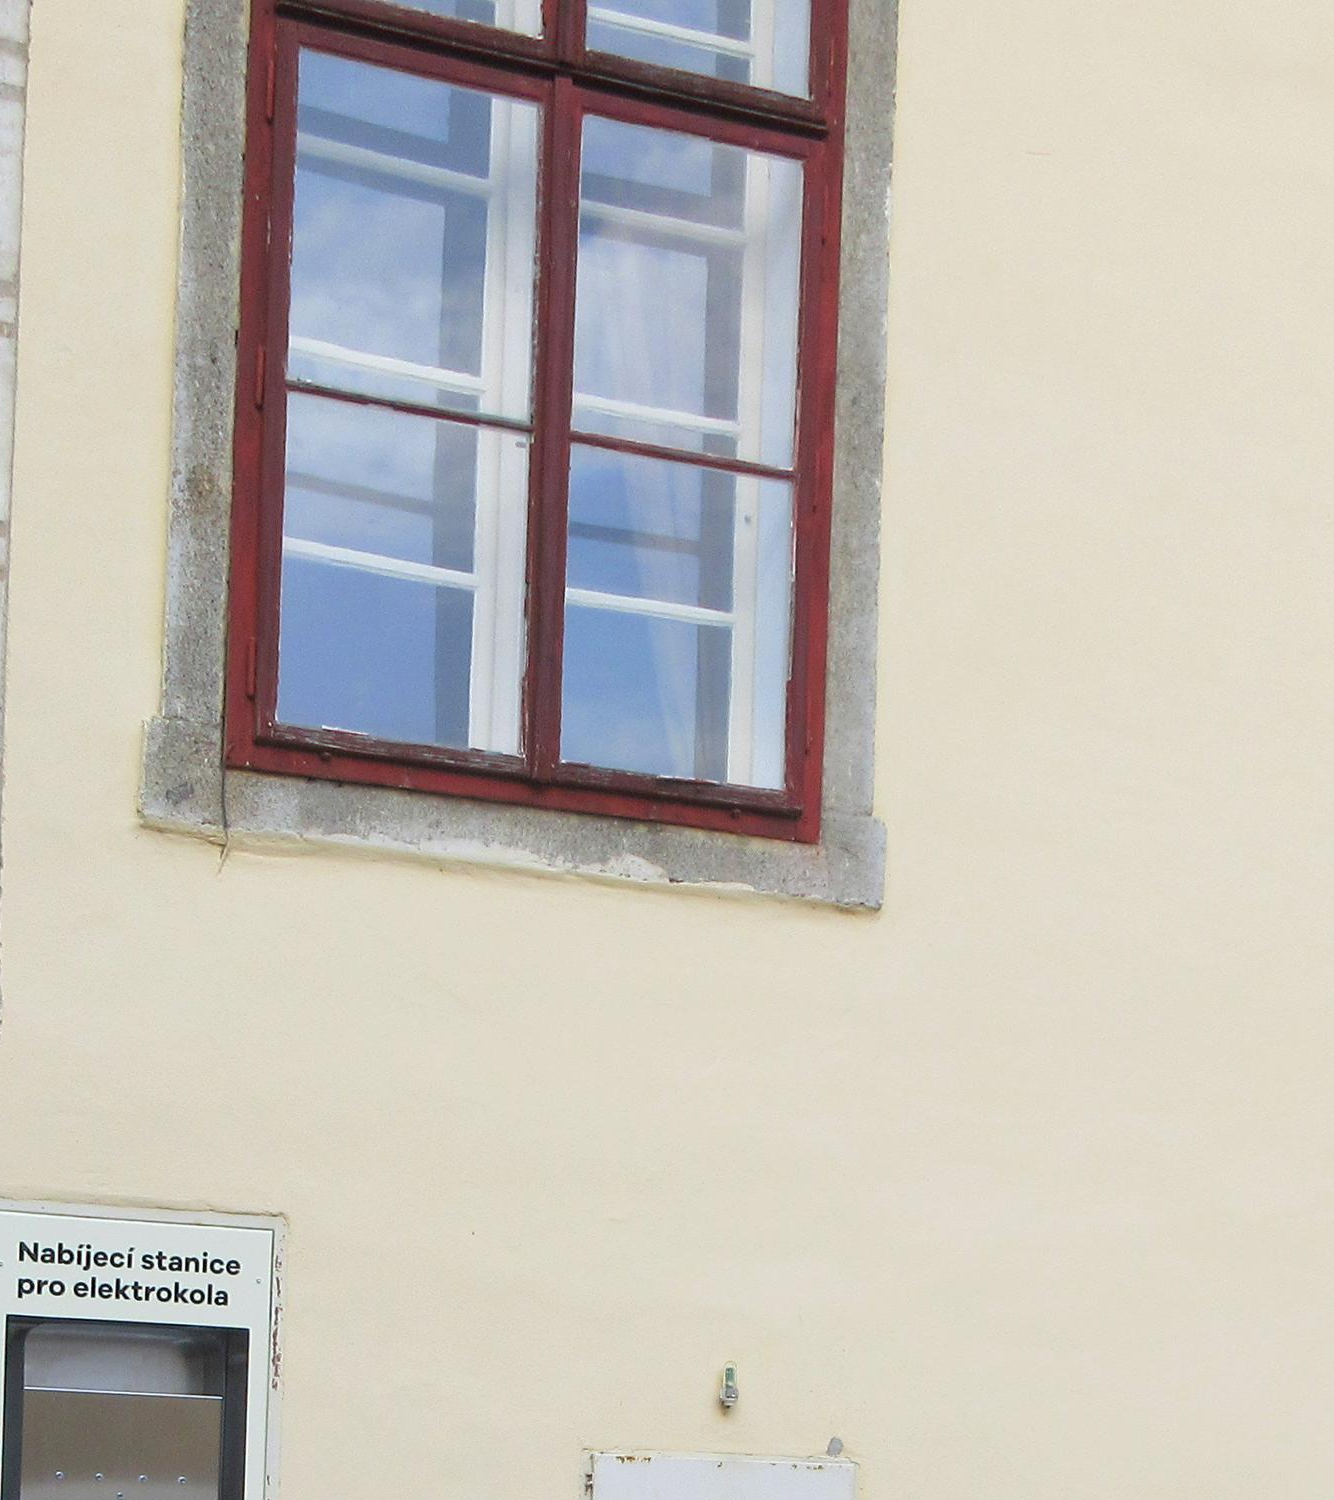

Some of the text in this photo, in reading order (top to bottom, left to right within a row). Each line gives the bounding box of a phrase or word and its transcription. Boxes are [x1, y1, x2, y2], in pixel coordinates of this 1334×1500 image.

[18, 1241, 241, 1276] Nabíjecí stanice
[17, 1277, 229, 1307] pro elektrokola
